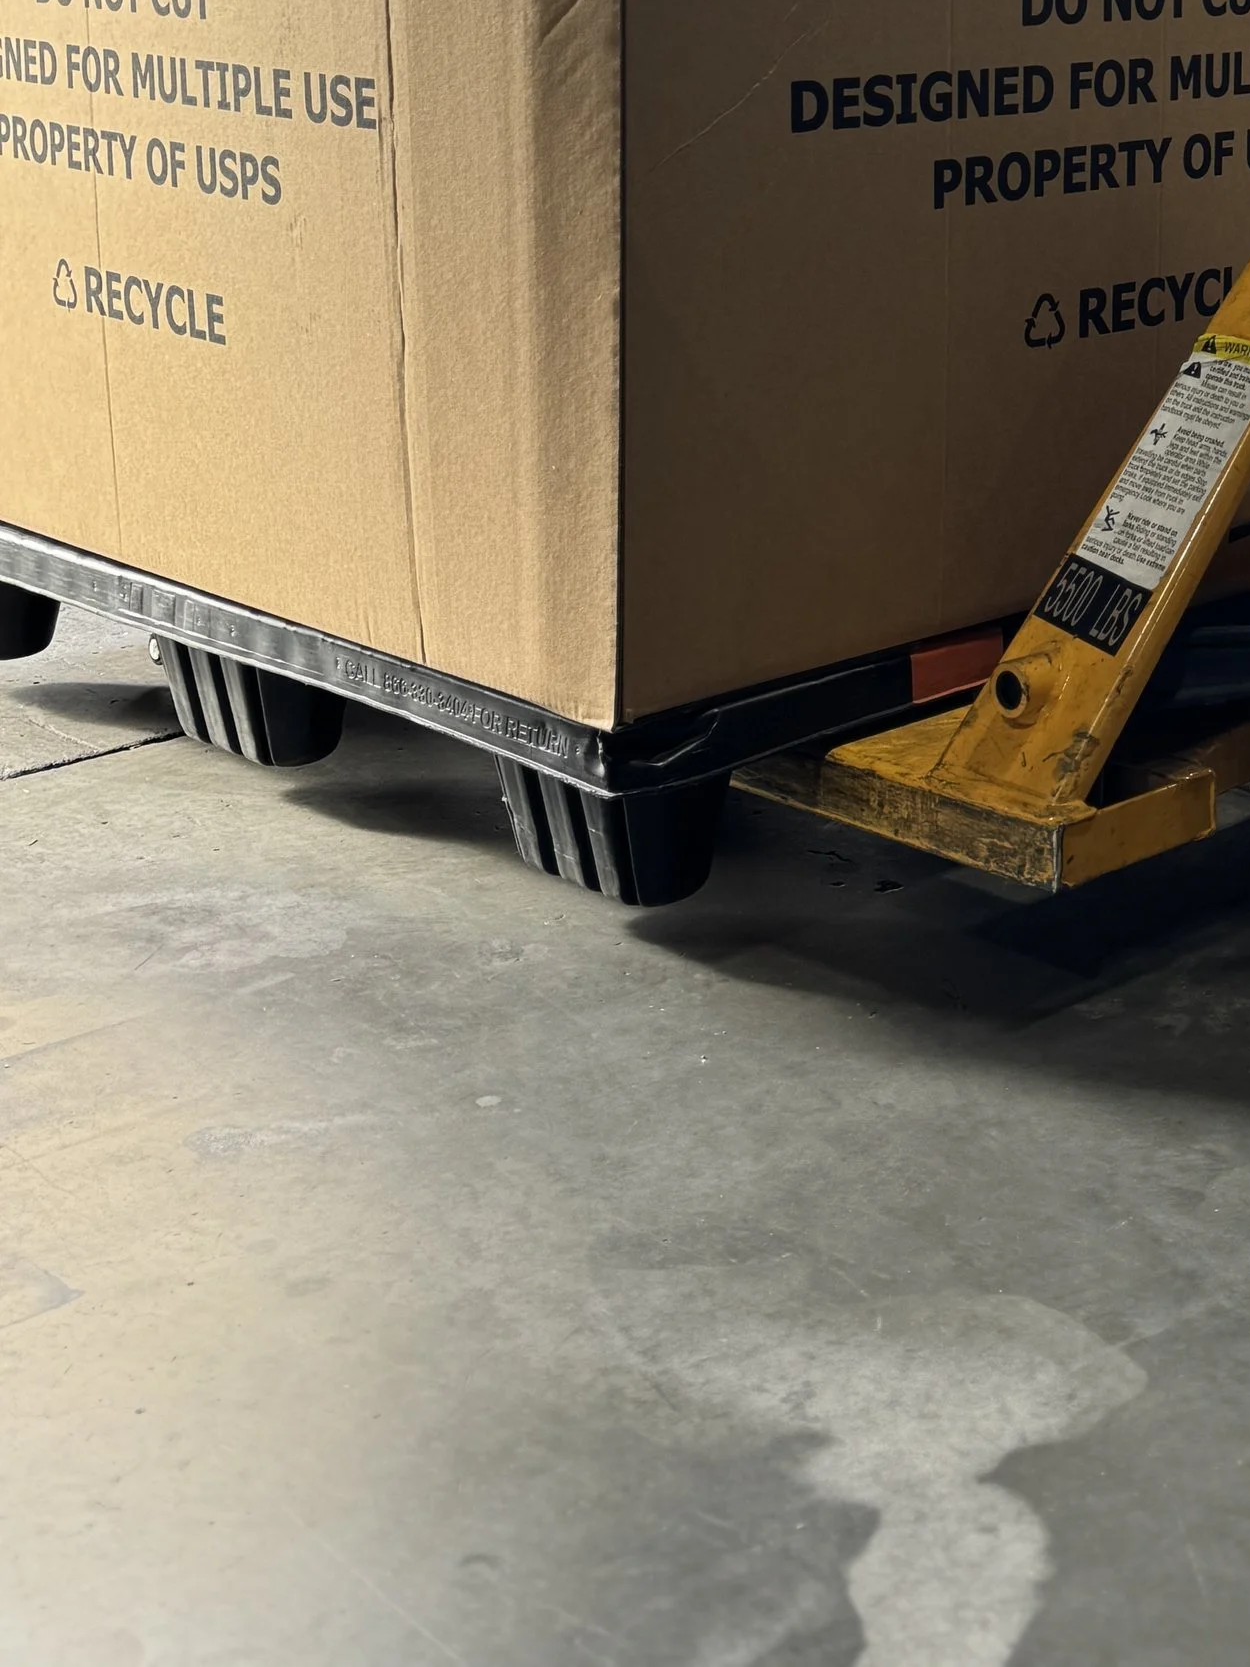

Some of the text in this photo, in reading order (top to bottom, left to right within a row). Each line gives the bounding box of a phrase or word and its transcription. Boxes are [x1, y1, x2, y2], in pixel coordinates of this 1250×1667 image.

[66, 44, 123, 96] FOR
[131, 52, 293, 119] MULTIPLE
[304, 71, 378, 130] USE
[791, 65, 1054, 134] DESIGNED
[1070, 57, 1158, 110] FOR
[146, 137, 186, 188] OF
[195, 145, 282, 205] USPS
[933, 137, 1173, 210] PROPERTY
[1183, 131, 1235, 179] OF
[84, 265, 226, 346] RECYCLE
[1044, 562, 1143, 646] 5500 LBS
[345, 660, 381, 689] CALL
[473, 705, 502, 736] FOR
[505, 716, 569, 759] RETURN
